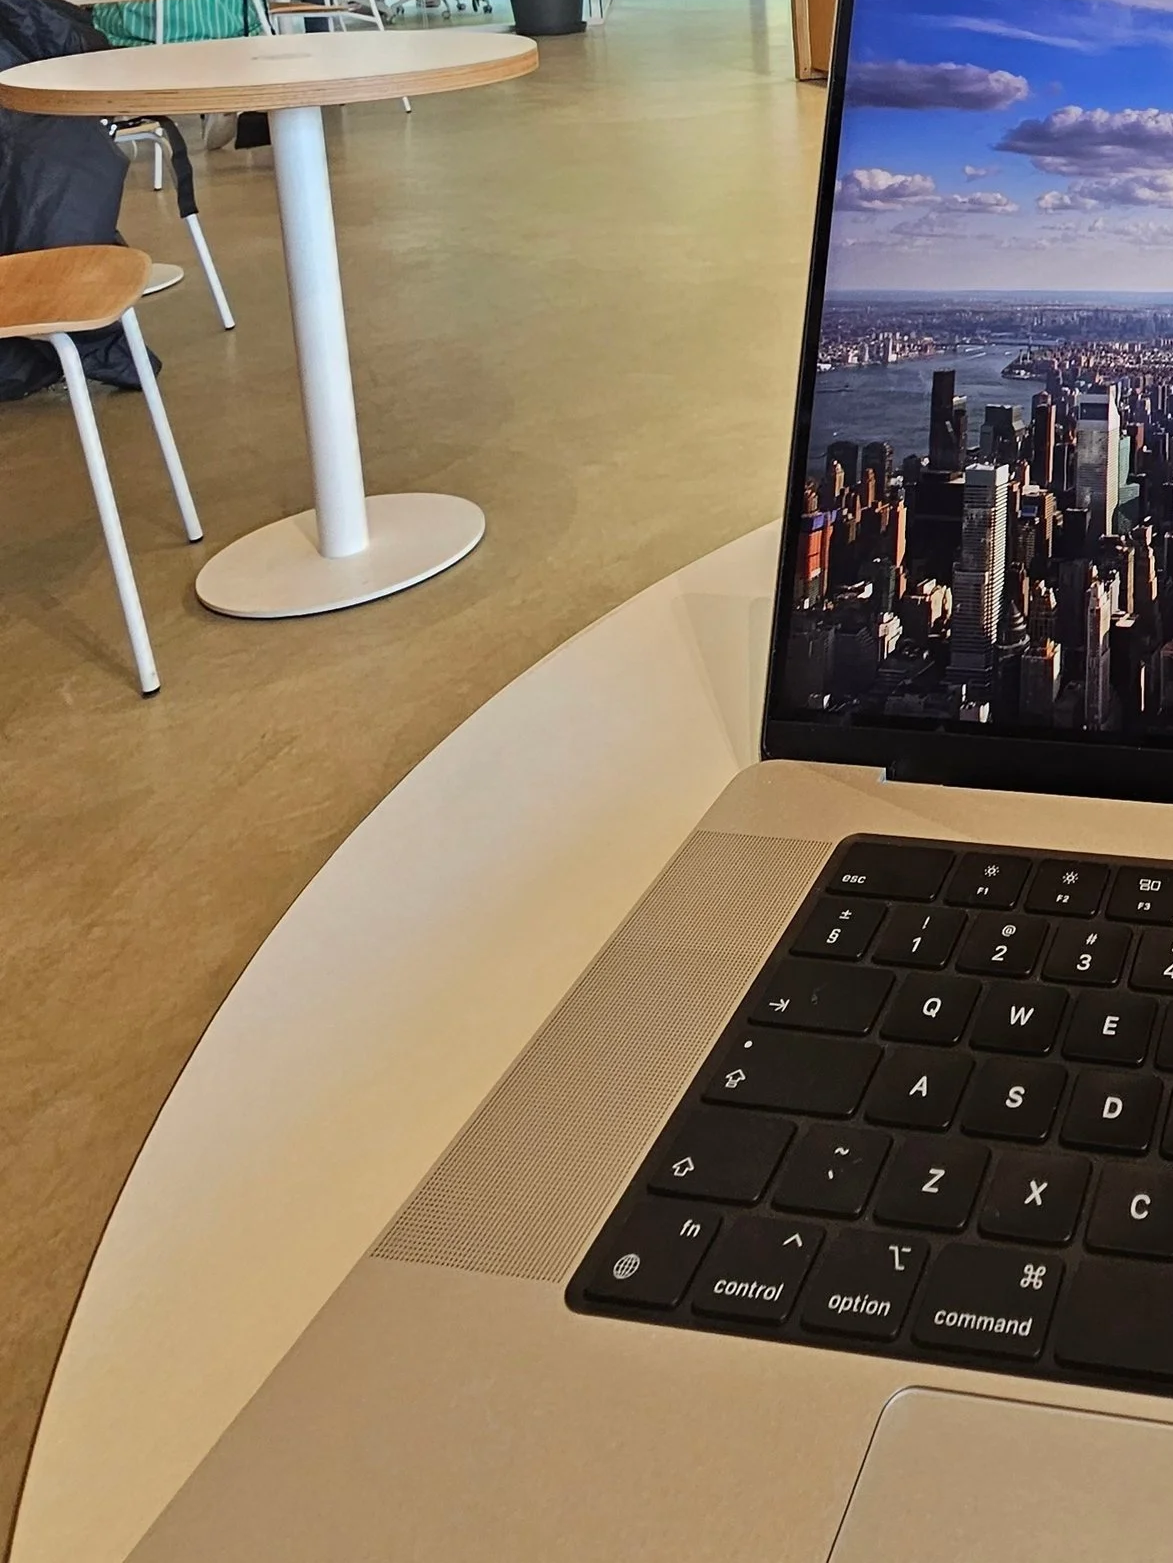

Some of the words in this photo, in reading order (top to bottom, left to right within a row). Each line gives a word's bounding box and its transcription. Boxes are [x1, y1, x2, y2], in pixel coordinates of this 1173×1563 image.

[841, 874, 867, 884] esc
[976, 886, 989, 895] F1
[1056, 894, 1070, 903] F2
[1137, 901, 1151, 911] F3
[911, 936, 922, 953] 1
[991, 945, 1008, 962] 2
[1076, 953, 1092, 971] 3
[922, 997, 942, 1018] Q
[1010, 1005, 1035, 1026] W
[1102, 1015, 1120, 1036] E
[909, 1075, 928, 1097] A
[1005, 1086, 1025, 1108] S
[1102, 1096, 1123, 1119] D
[921, 1168, 946, 1193] Z
[1024, 1179, 1048, 1206] X
[1130, 1193, 1151, 1220] C
[679, 1219, 701, 1238] fn
[713, 1279, 784, 1301] control
[828, 1294, 891, 1317] option
[934, 1310, 1033, 1336] command
